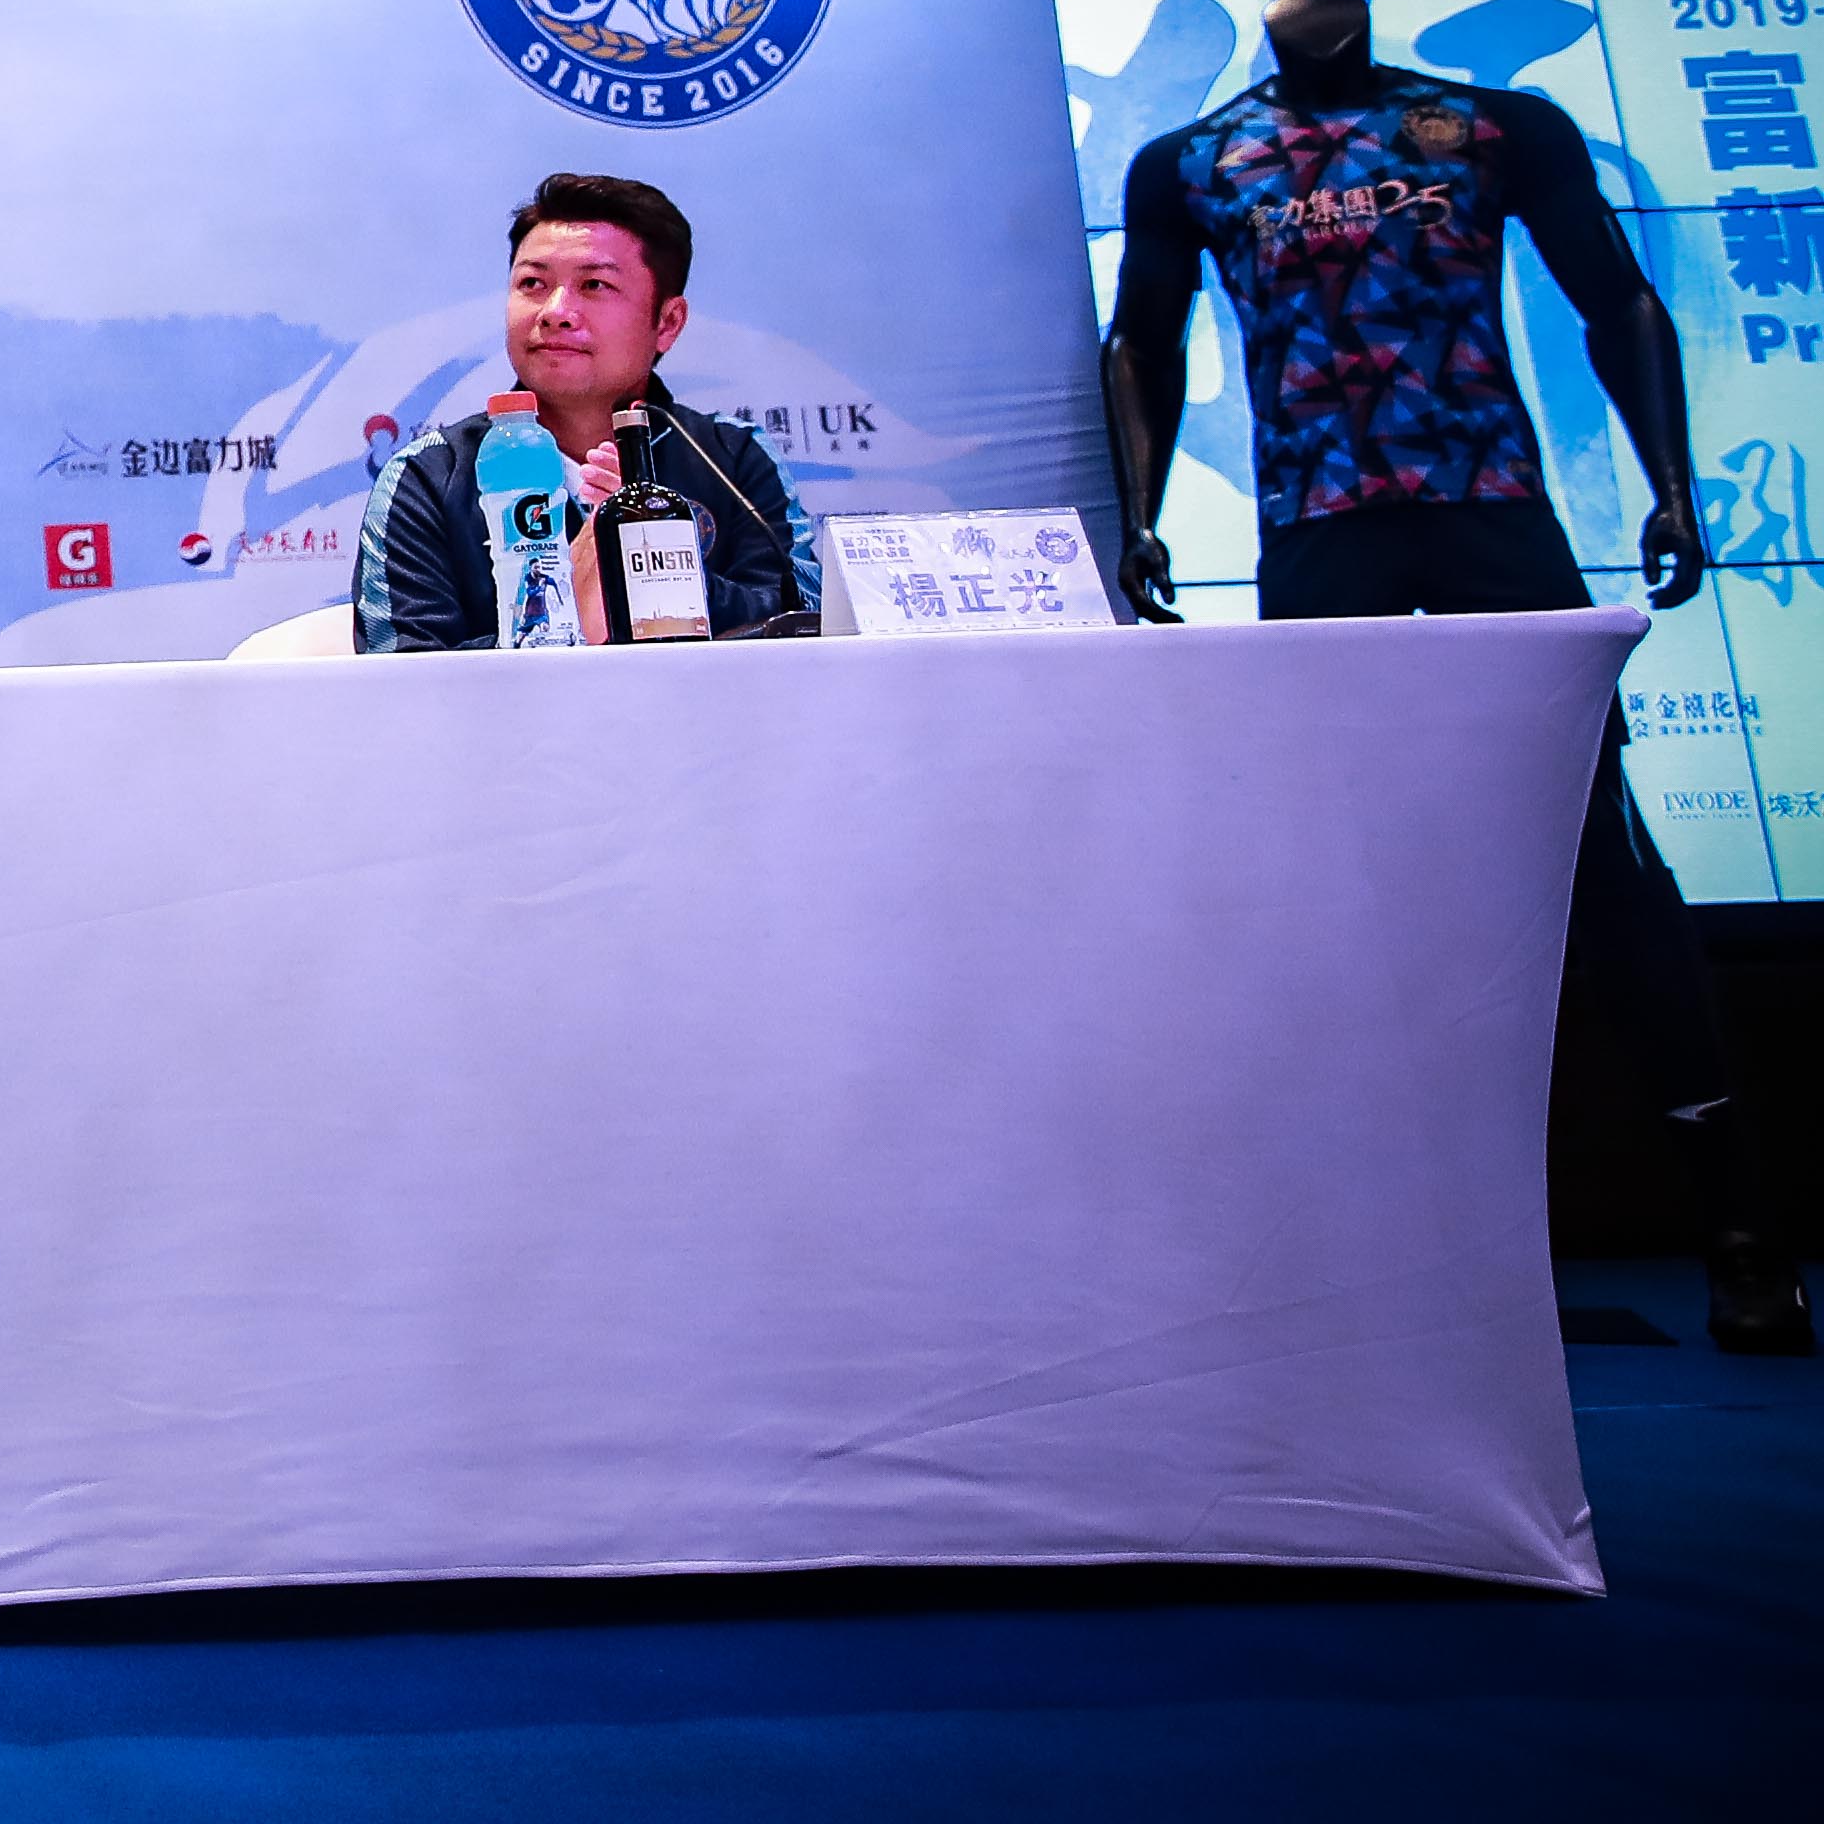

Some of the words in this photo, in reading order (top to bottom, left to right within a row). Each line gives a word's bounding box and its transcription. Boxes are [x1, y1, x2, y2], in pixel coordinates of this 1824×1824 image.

[519, 43, 665, 116] SINCE
[684, 38, 785, 112] 2016
[819, 403, 879, 434] UK
[121, 435, 278, 478] 金边富力城
[514, 494, 553, 540] G
[58, 528, 97, 571] G
